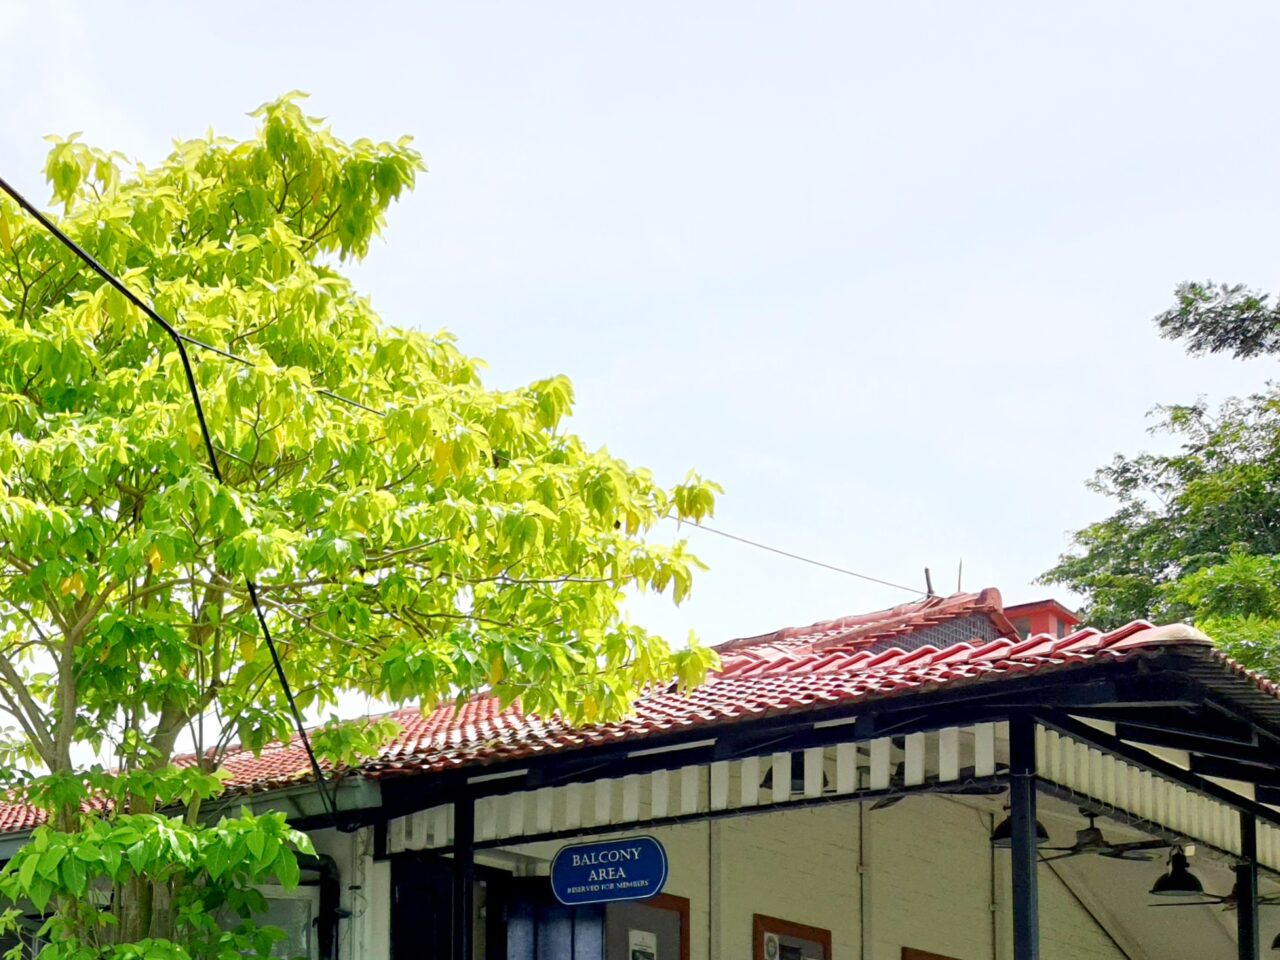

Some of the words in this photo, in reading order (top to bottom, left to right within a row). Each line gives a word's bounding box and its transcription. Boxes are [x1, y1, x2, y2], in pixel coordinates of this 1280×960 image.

[572, 847, 642, 866] BALCONY
[588, 866, 627, 881] AREA
[567, 884, 600, 894] RESERVED
[616, 880, 649, 889] MEMBERS
